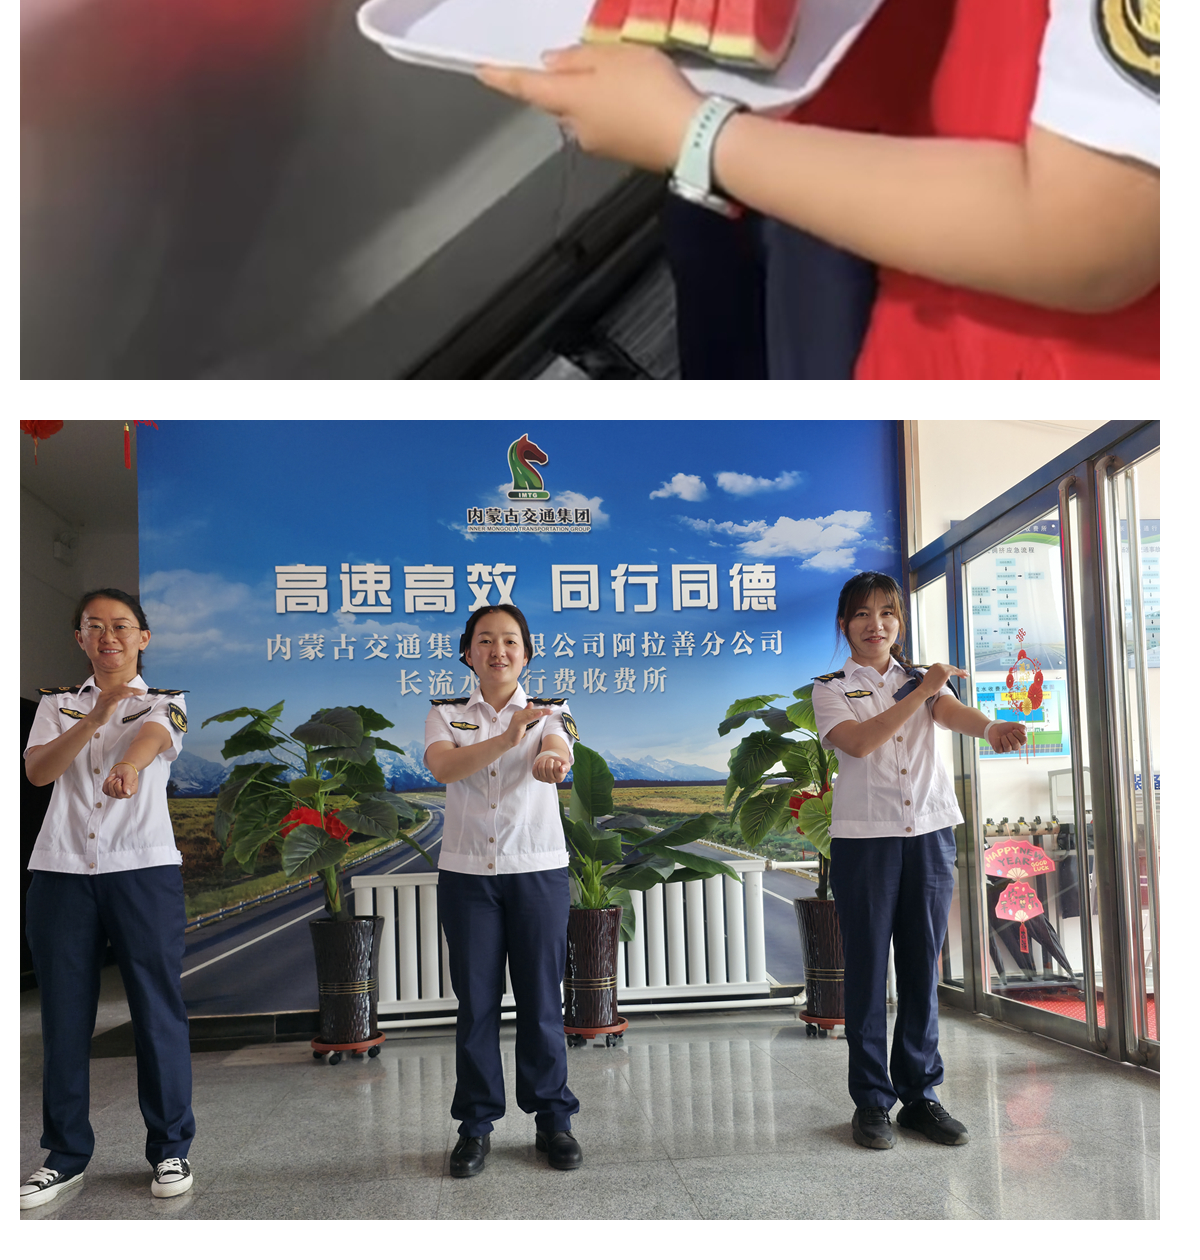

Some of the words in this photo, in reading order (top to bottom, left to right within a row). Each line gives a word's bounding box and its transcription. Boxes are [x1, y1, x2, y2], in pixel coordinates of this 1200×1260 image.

[467, 507, 591, 524] 内蒙古交通集团
[274, 562, 517, 614] 高速高效
[551, 562, 777, 613] 同行同德
[266, 629, 783, 661] 内蒙古交通集限公司阿拉善分公司
[396, 666, 667, 697] 长流水行费收费所
[985, 846, 1019, 863] HAPPY
[1019, 847, 1044, 860] NEW
[997, 856, 1030, 866] YEAR
[1031, 860, 1047, 868] GOOD
